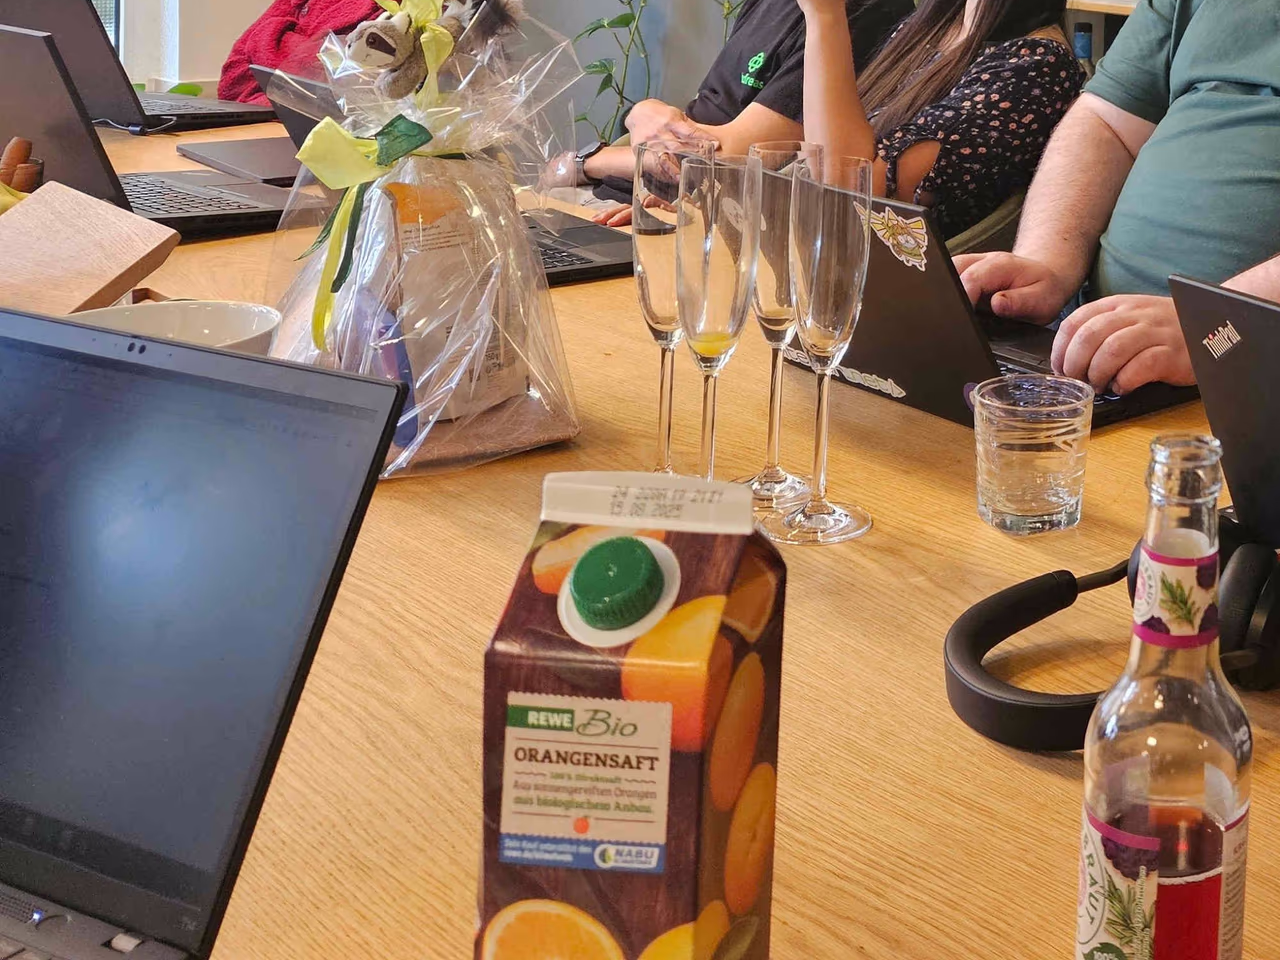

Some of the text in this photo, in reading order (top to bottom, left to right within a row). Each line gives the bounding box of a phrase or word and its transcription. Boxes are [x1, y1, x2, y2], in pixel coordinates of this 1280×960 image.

[1202, 320, 1241, 360] ThinkPad
[527, 708, 638, 737] REWE Bio
[514, 747, 660, 771] ORANGENSAFT
[614, 787, 658, 801] Orangen
[614, 848, 655, 860] NABU
